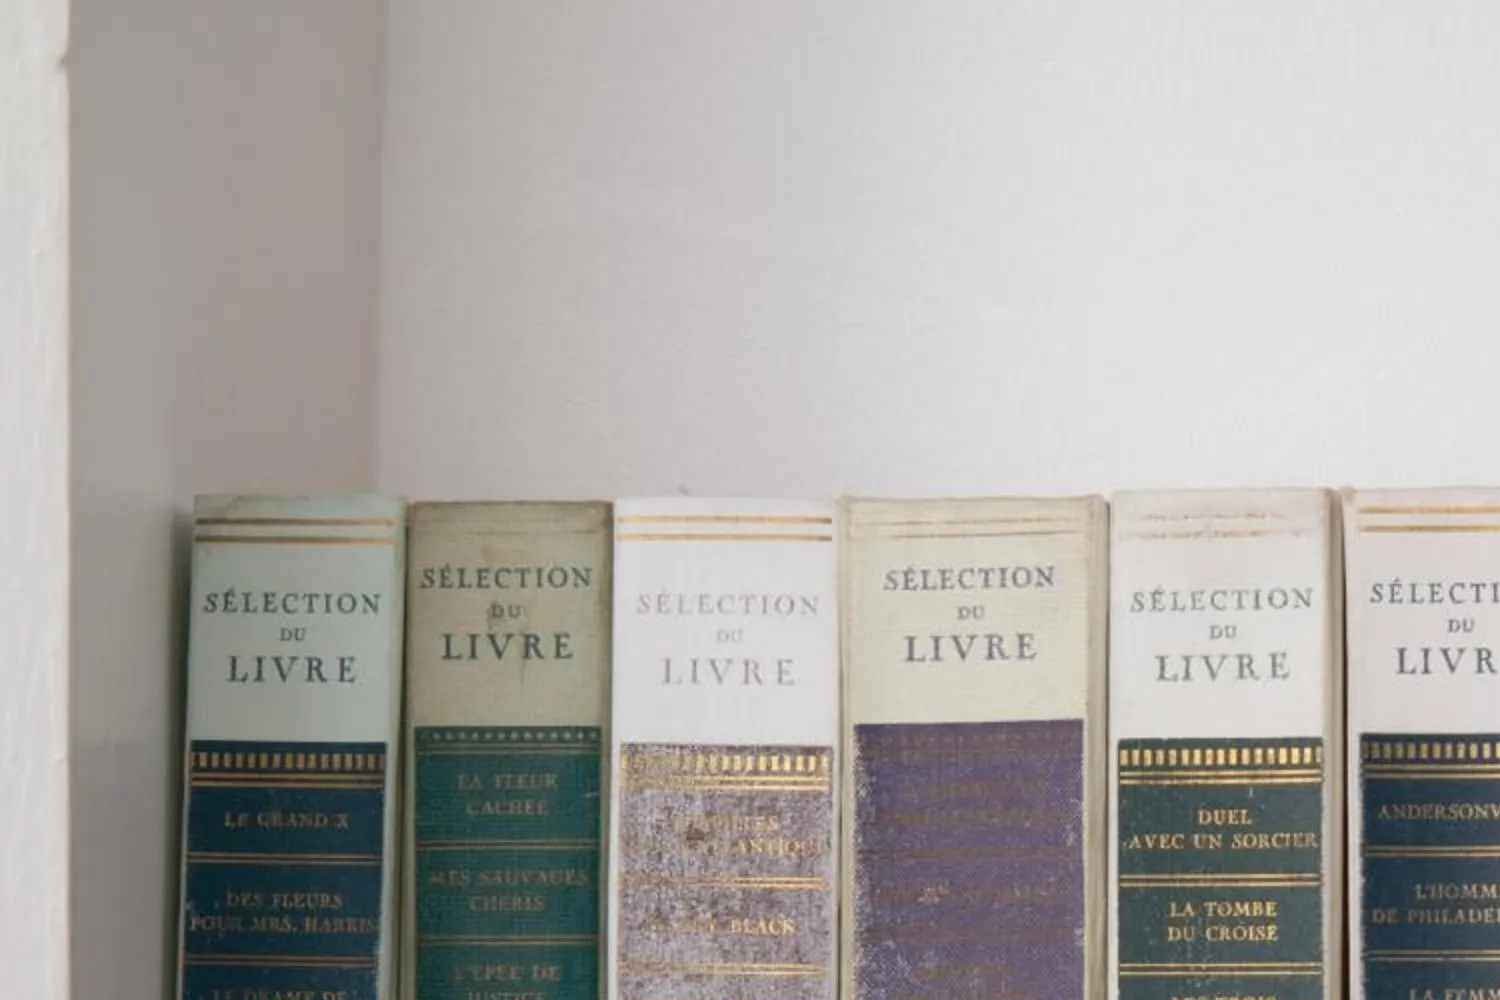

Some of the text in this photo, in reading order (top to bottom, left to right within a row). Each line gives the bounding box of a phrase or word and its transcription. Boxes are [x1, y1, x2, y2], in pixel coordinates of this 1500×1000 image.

[420, 564, 592, 589] SÉLECTION
[883, 566, 1055, 592] SÉLECTION
[203, 587, 381, 615] SÉLECTION
[636, 592, 820, 616] SÉLECTION
[1130, 585, 1314, 612] SÉLECTION
[491, 604, 521, 618] DU
[956, 606, 986, 620] DU
[1209, 625, 1236, 640] DU
[1447, 618, 1475, 633] DU
[280, 627, 307, 642] DU
[716, 629, 743, 644] DU
[442, 632, 573, 661] LIVRE
[905, 633, 1038, 662] LIVRE
[227, 655, 356, 684] LIVRE
[661, 658, 796, 687] LIVRE
[1155, 653, 1291, 682] LIVRE
[224, 812, 248, 828] LE
[257, 813, 328, 828] GRAND
[1198, 809, 1253, 825] DUEL
[1128, 832, 1319, 849] AVEC UN SORCIER
[226, 892, 343, 908] DES FLEURS
[1170, 901, 1278, 917] LA TOMBE
[1372, 908, 1398, 924] DE
[731, 918, 796, 934] BLACK
[1167, 926, 1195, 941] DU
